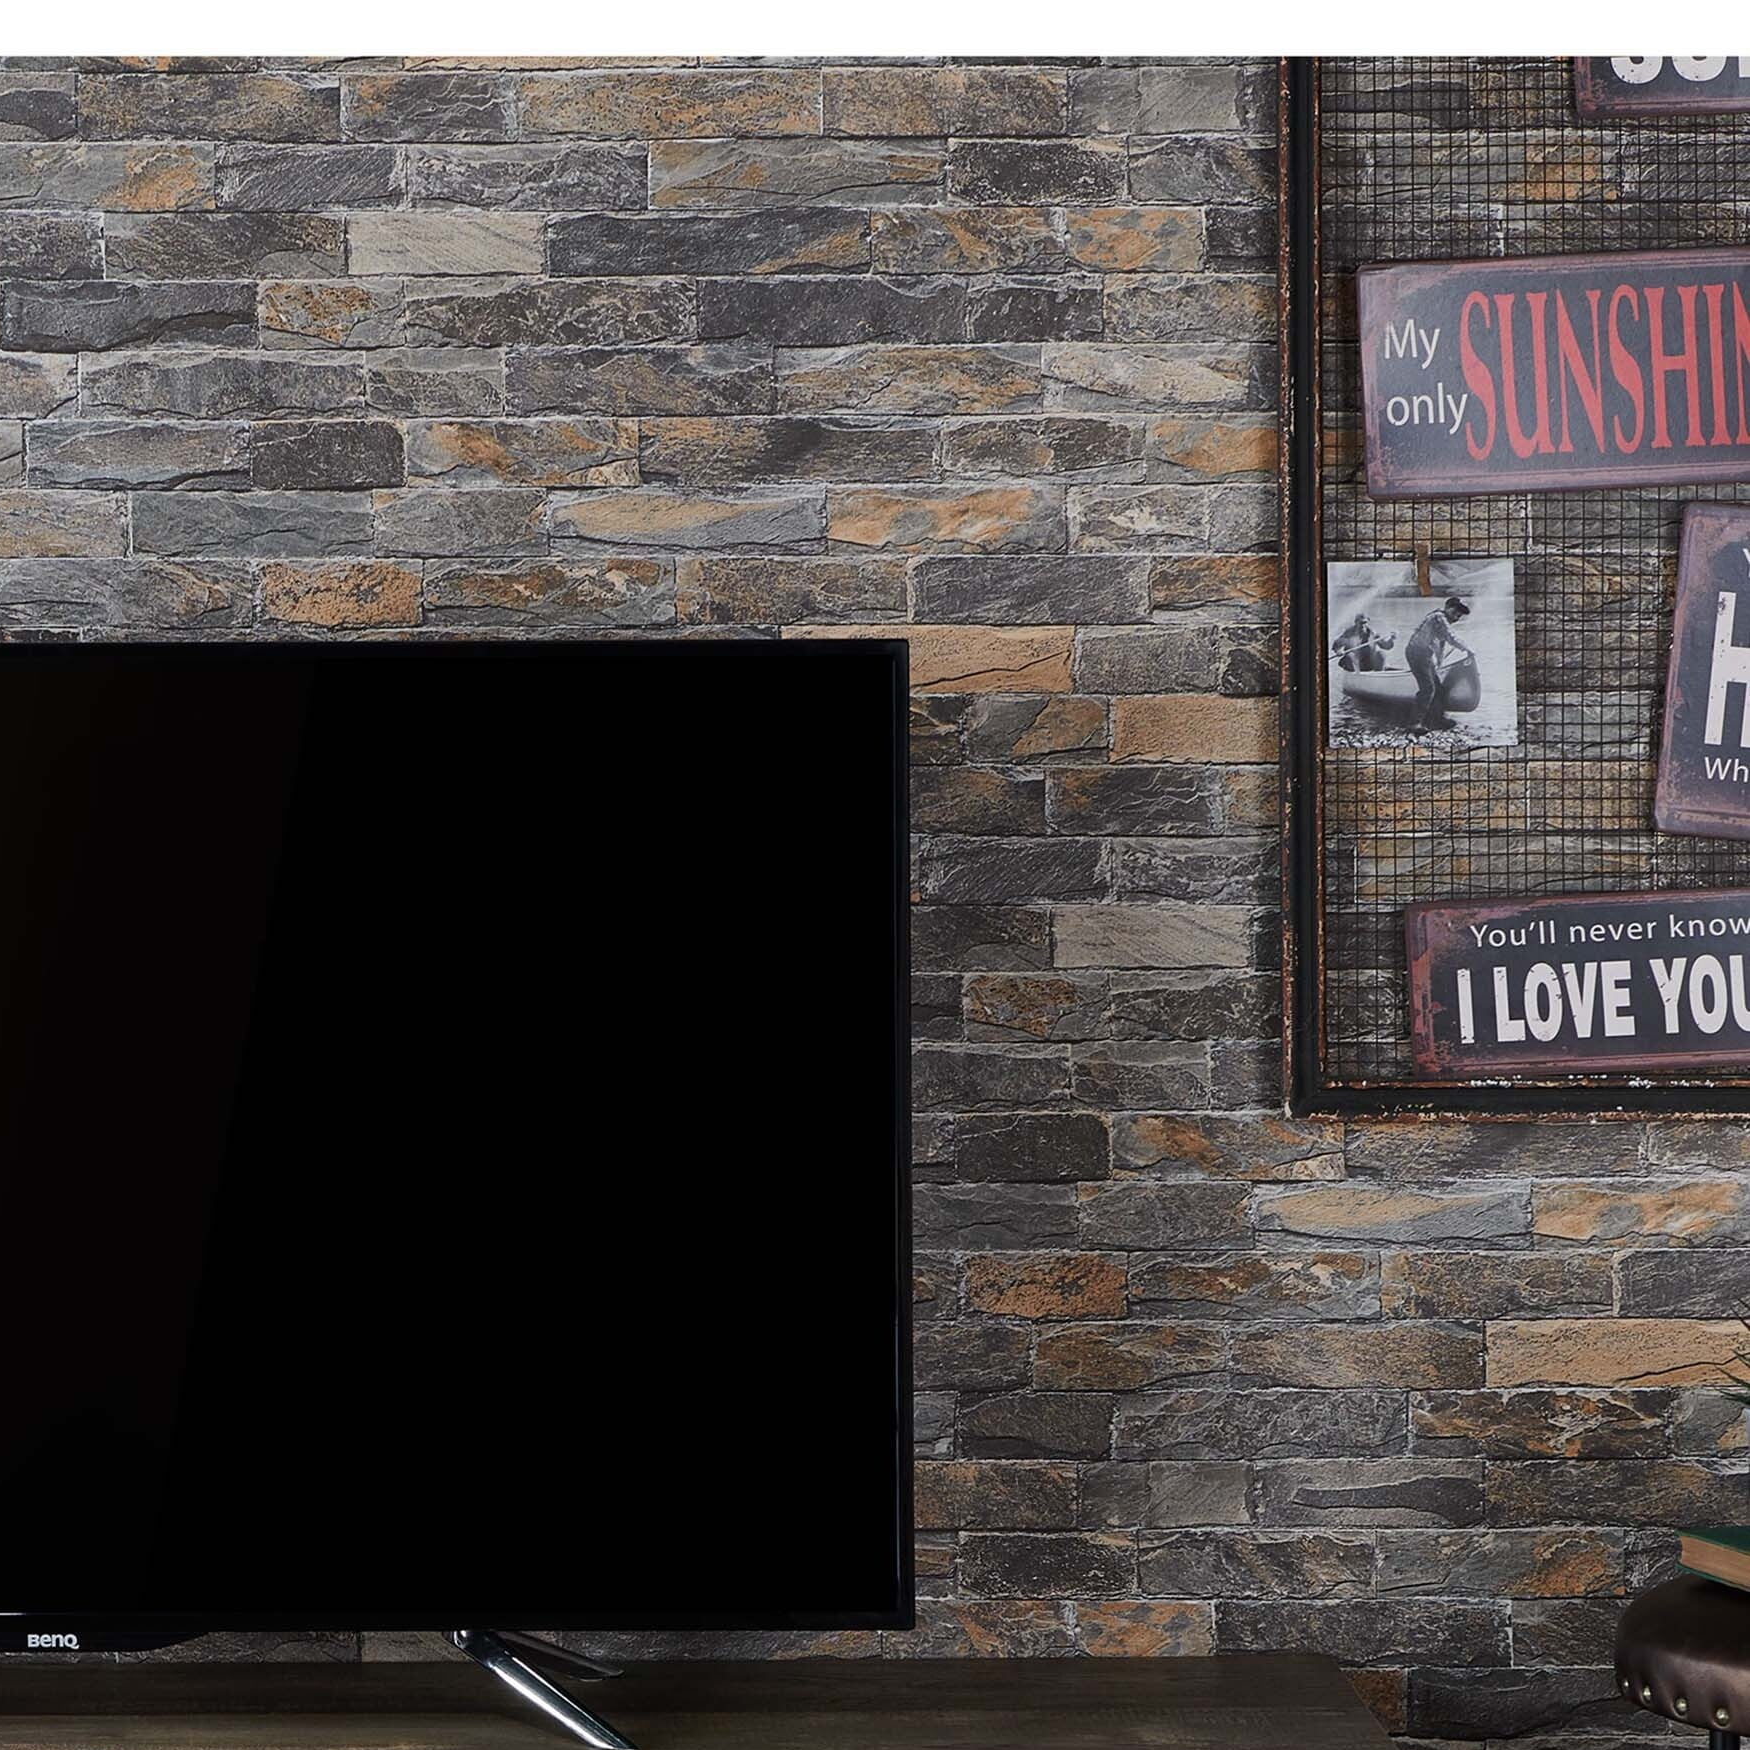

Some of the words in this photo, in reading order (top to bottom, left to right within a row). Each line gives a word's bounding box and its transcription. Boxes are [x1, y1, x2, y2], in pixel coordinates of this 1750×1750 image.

[1384, 319, 1440, 370] My
[1386, 382, 1468, 434] only
[1569, 921, 1657, 943] never
[1457, 968, 1475, 1044] I
[1493, 959, 1636, 1042] LOVE
